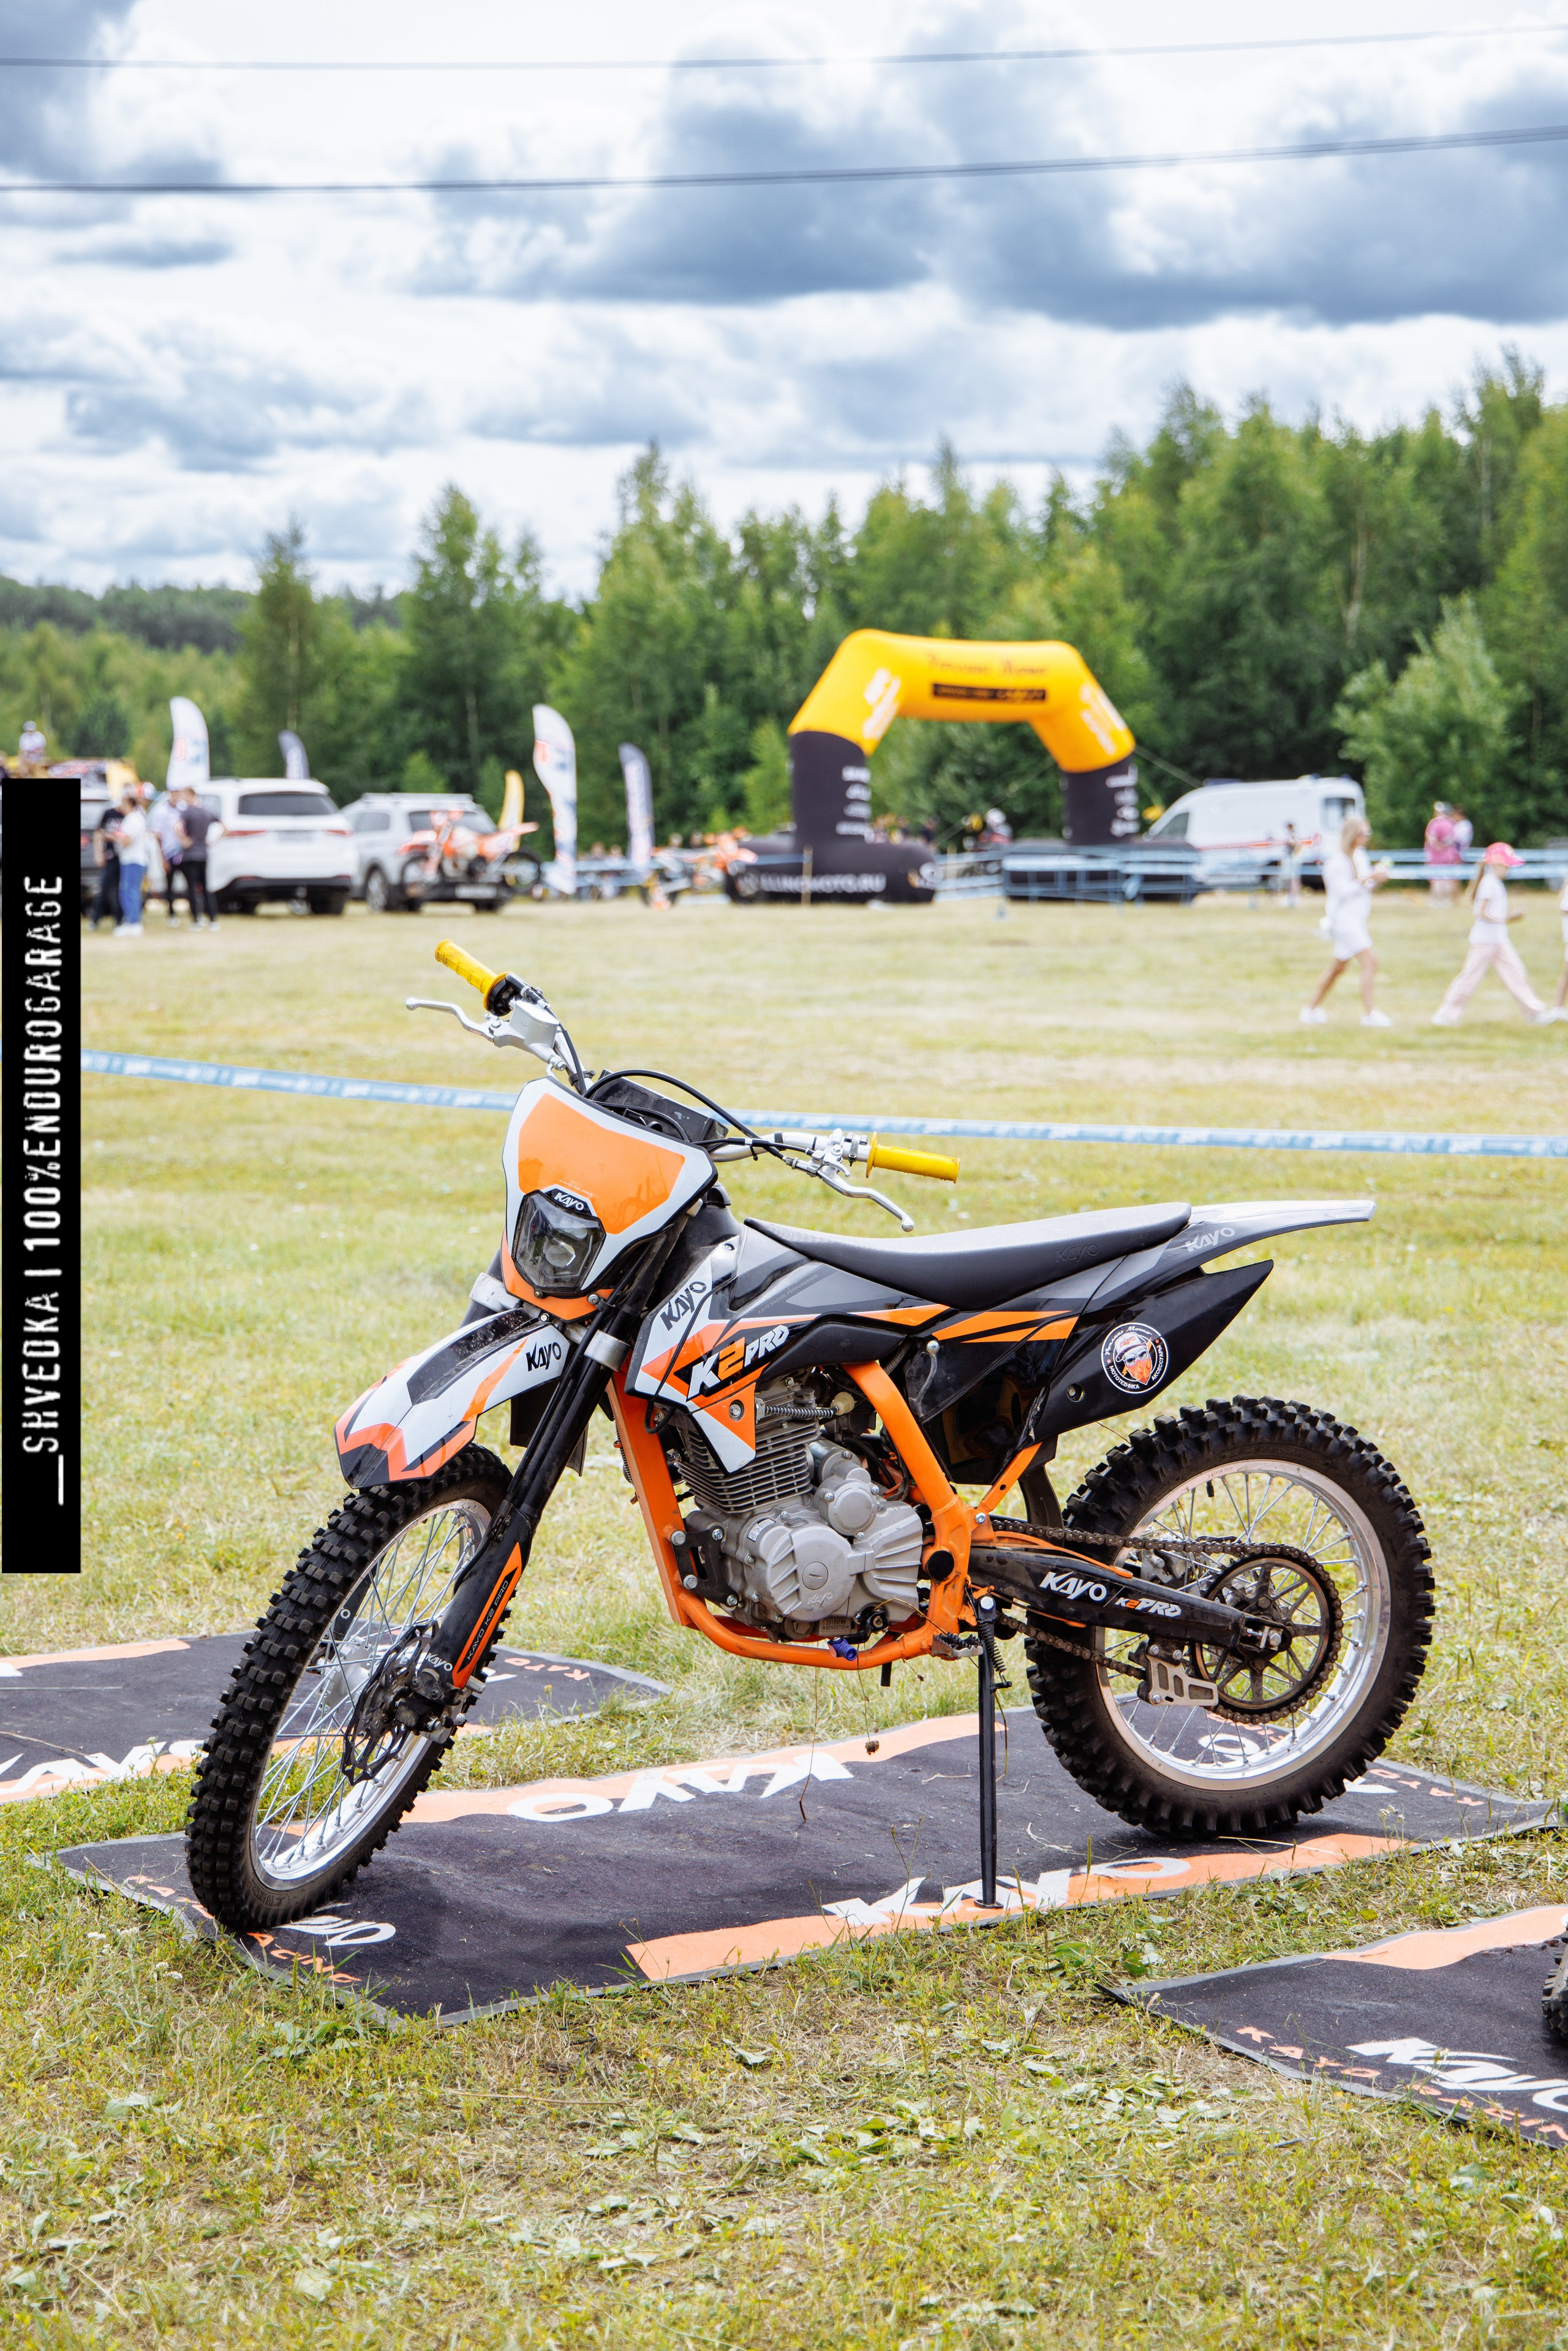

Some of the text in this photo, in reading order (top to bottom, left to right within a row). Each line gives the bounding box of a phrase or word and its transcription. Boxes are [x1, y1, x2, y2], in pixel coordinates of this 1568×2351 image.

[554, 1192, 584, 1211] KAYO
[1185, 1226, 1236, 1253] KAYO
[660, 1281, 707, 1331] KAYO
[526, 1342, 562, 1372] KAYO
[1152, 1345, 1164, 1381] АКСЕССУАРЫ
[1109, 1365, 1140, 1389] МОТОТЕХНИКА
[1039, 1571, 1107, 1601] KAYO
[467, 1628, 484, 1660] KAYO
[494, 1580, 508, 1606] PRO
[425, 1653, 453, 1672] KAYO
[508, 1751, 855, 1822] KAYO
